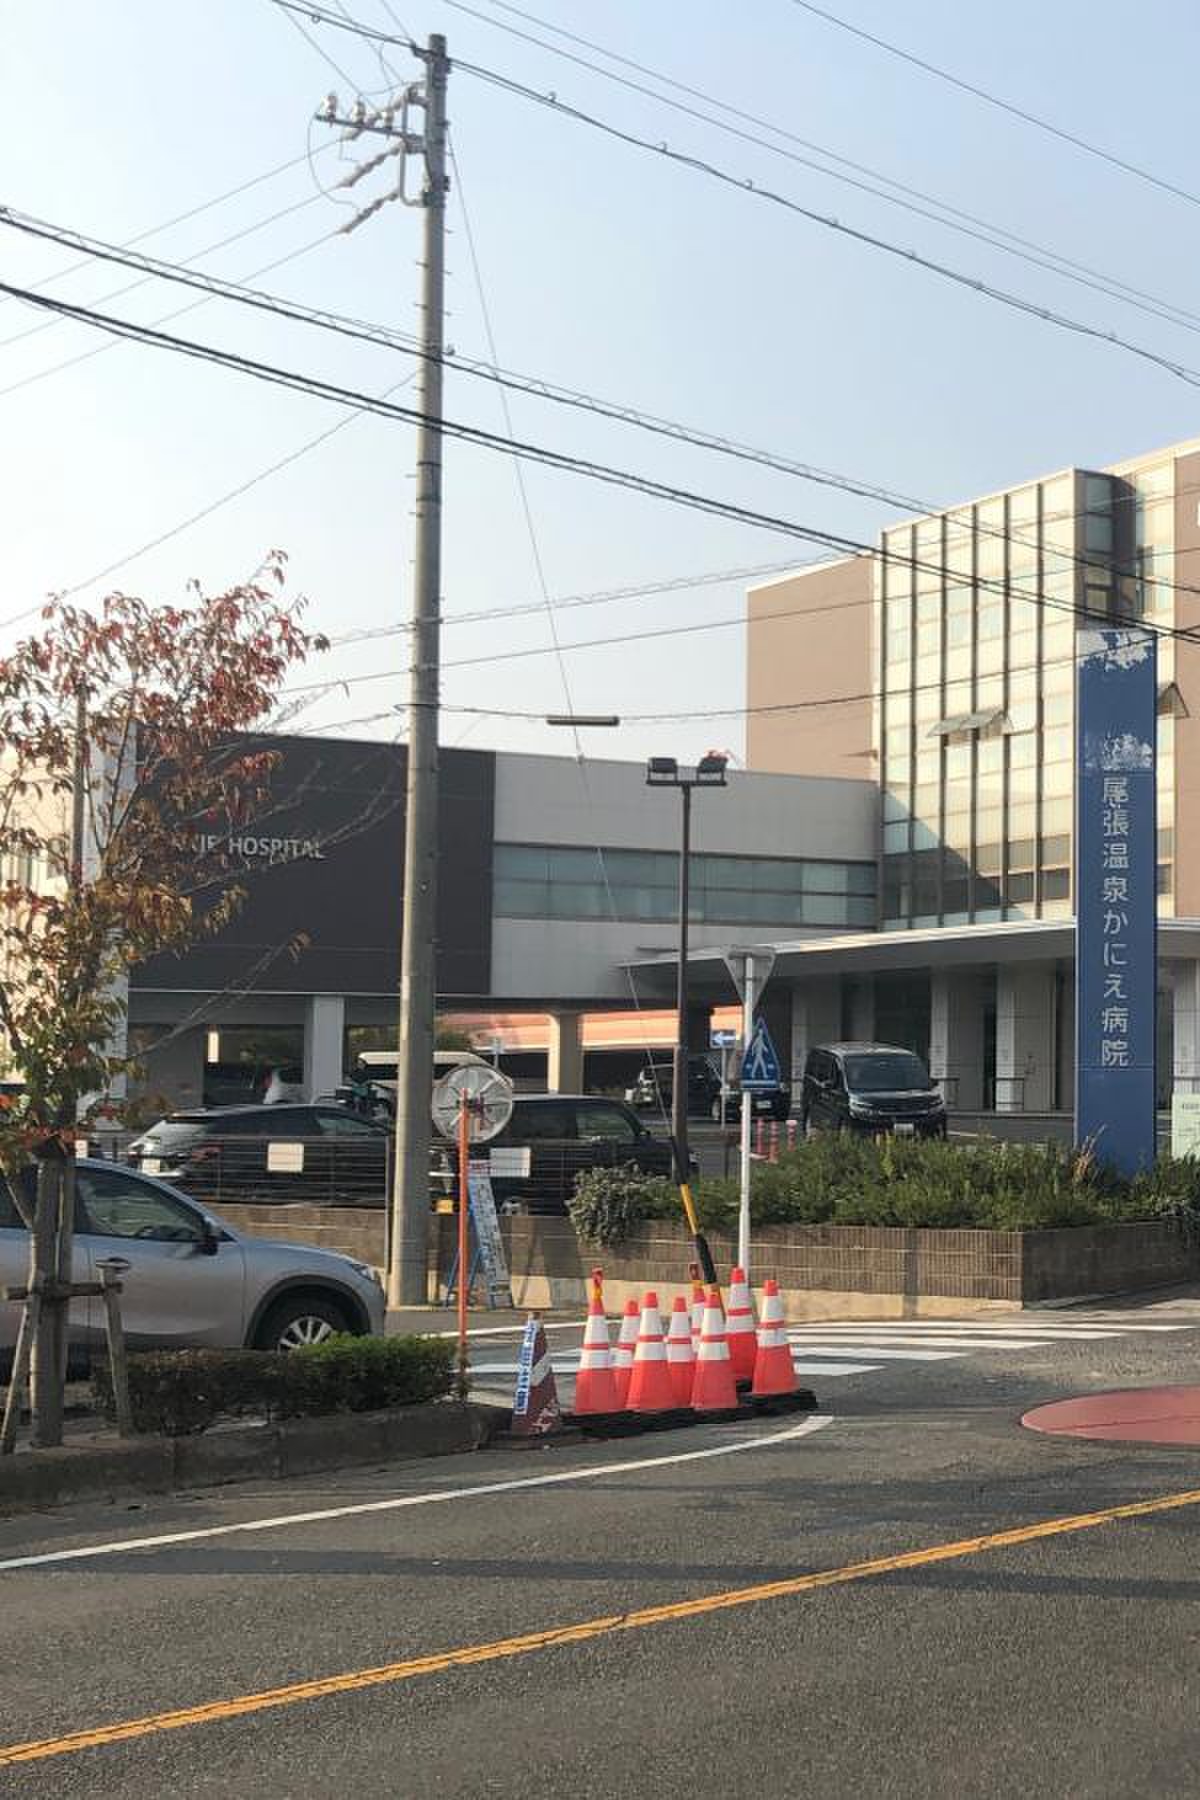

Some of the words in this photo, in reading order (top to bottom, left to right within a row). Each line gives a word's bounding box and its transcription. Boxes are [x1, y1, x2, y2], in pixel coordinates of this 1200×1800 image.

[229, 837, 325, 859] HOSPITAL
[1101, 777, 1129, 1067] 尾張温泉かにえ病院
